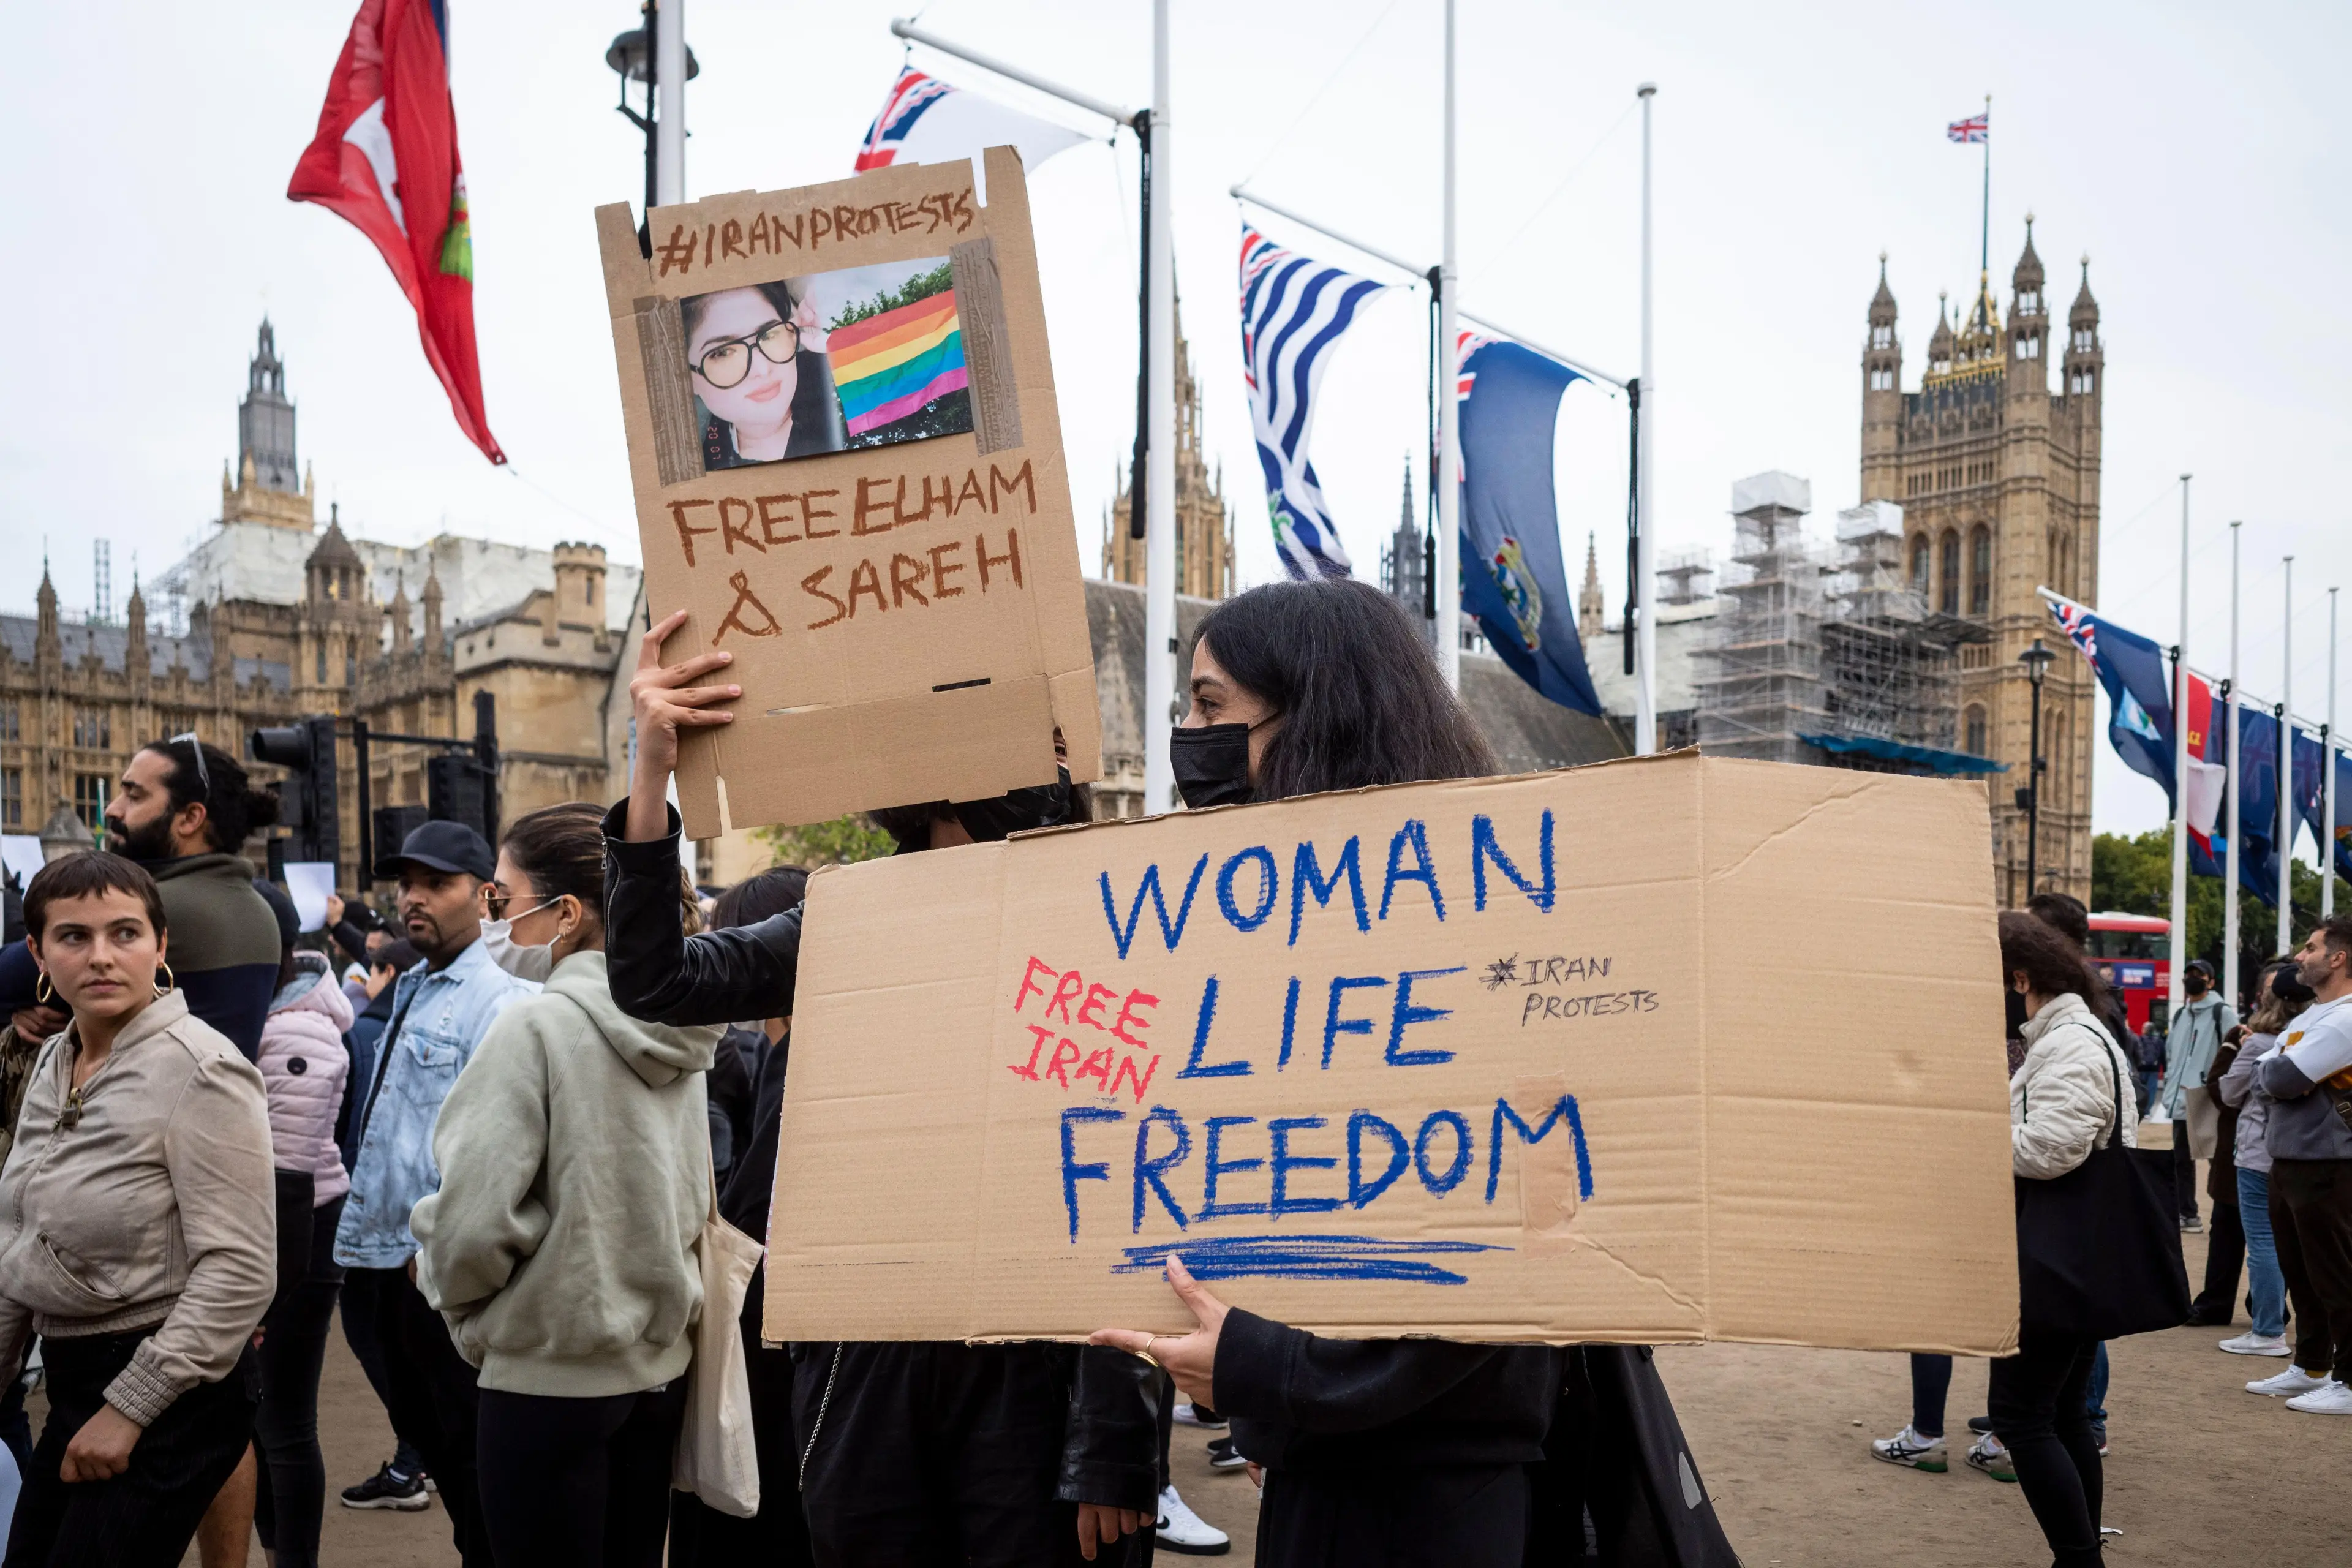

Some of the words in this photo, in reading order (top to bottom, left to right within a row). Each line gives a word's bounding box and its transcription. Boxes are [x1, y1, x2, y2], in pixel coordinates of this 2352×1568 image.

[656, 187, 973, 277] #IRANPROTESTS
[666, 490, 840, 568] FREE
[851, 459, 1037, 537] ELHAM
[801, 527, 1023, 631] SAREH
[1098, 807, 1555, 960] WOMAN
[1014, 956, 1160, 1050] FREE
[1175, 966, 1468, 1080] LIFE
[1522, 989, 1659, 1027] PROTESTS
[1007, 1025, 1161, 1104] IRAN
[1060, 1094, 1595, 1246] FREEDOM
